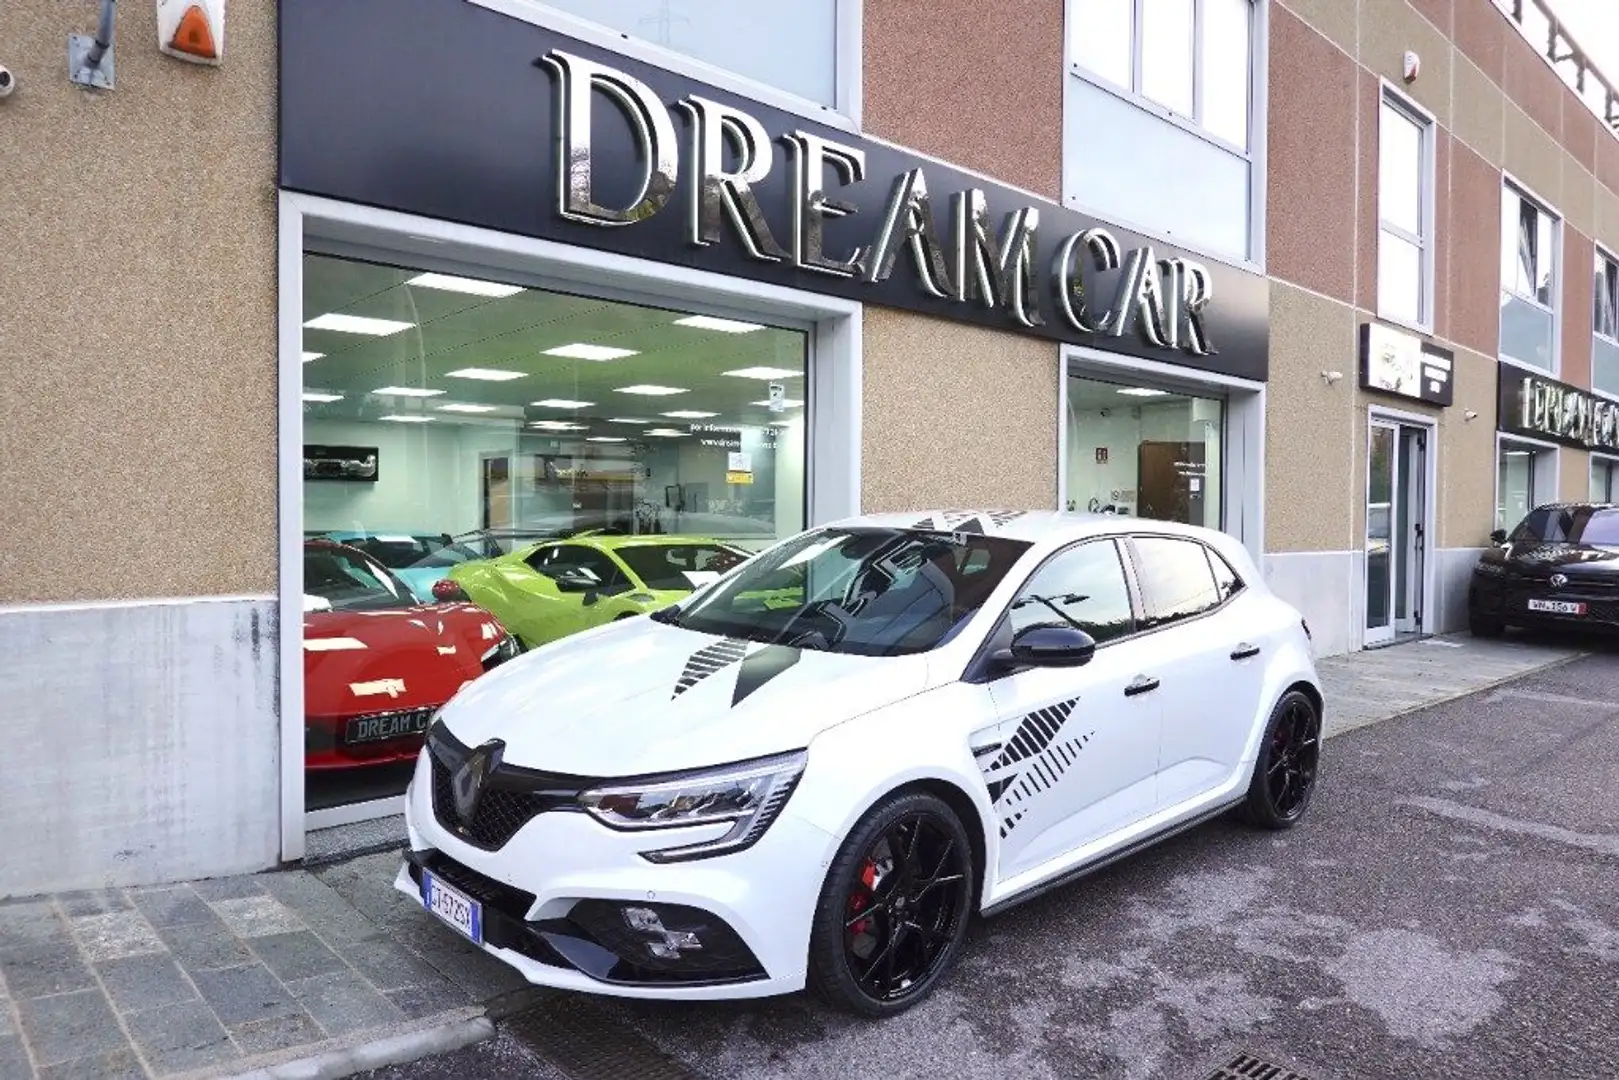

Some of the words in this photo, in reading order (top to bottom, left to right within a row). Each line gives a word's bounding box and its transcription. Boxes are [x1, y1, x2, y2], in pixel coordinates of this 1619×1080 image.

[534, 49, 1046, 327] DREAM
[1051, 227, 1219, 355] CAR
[358, 714, 411, 739] DREAM
